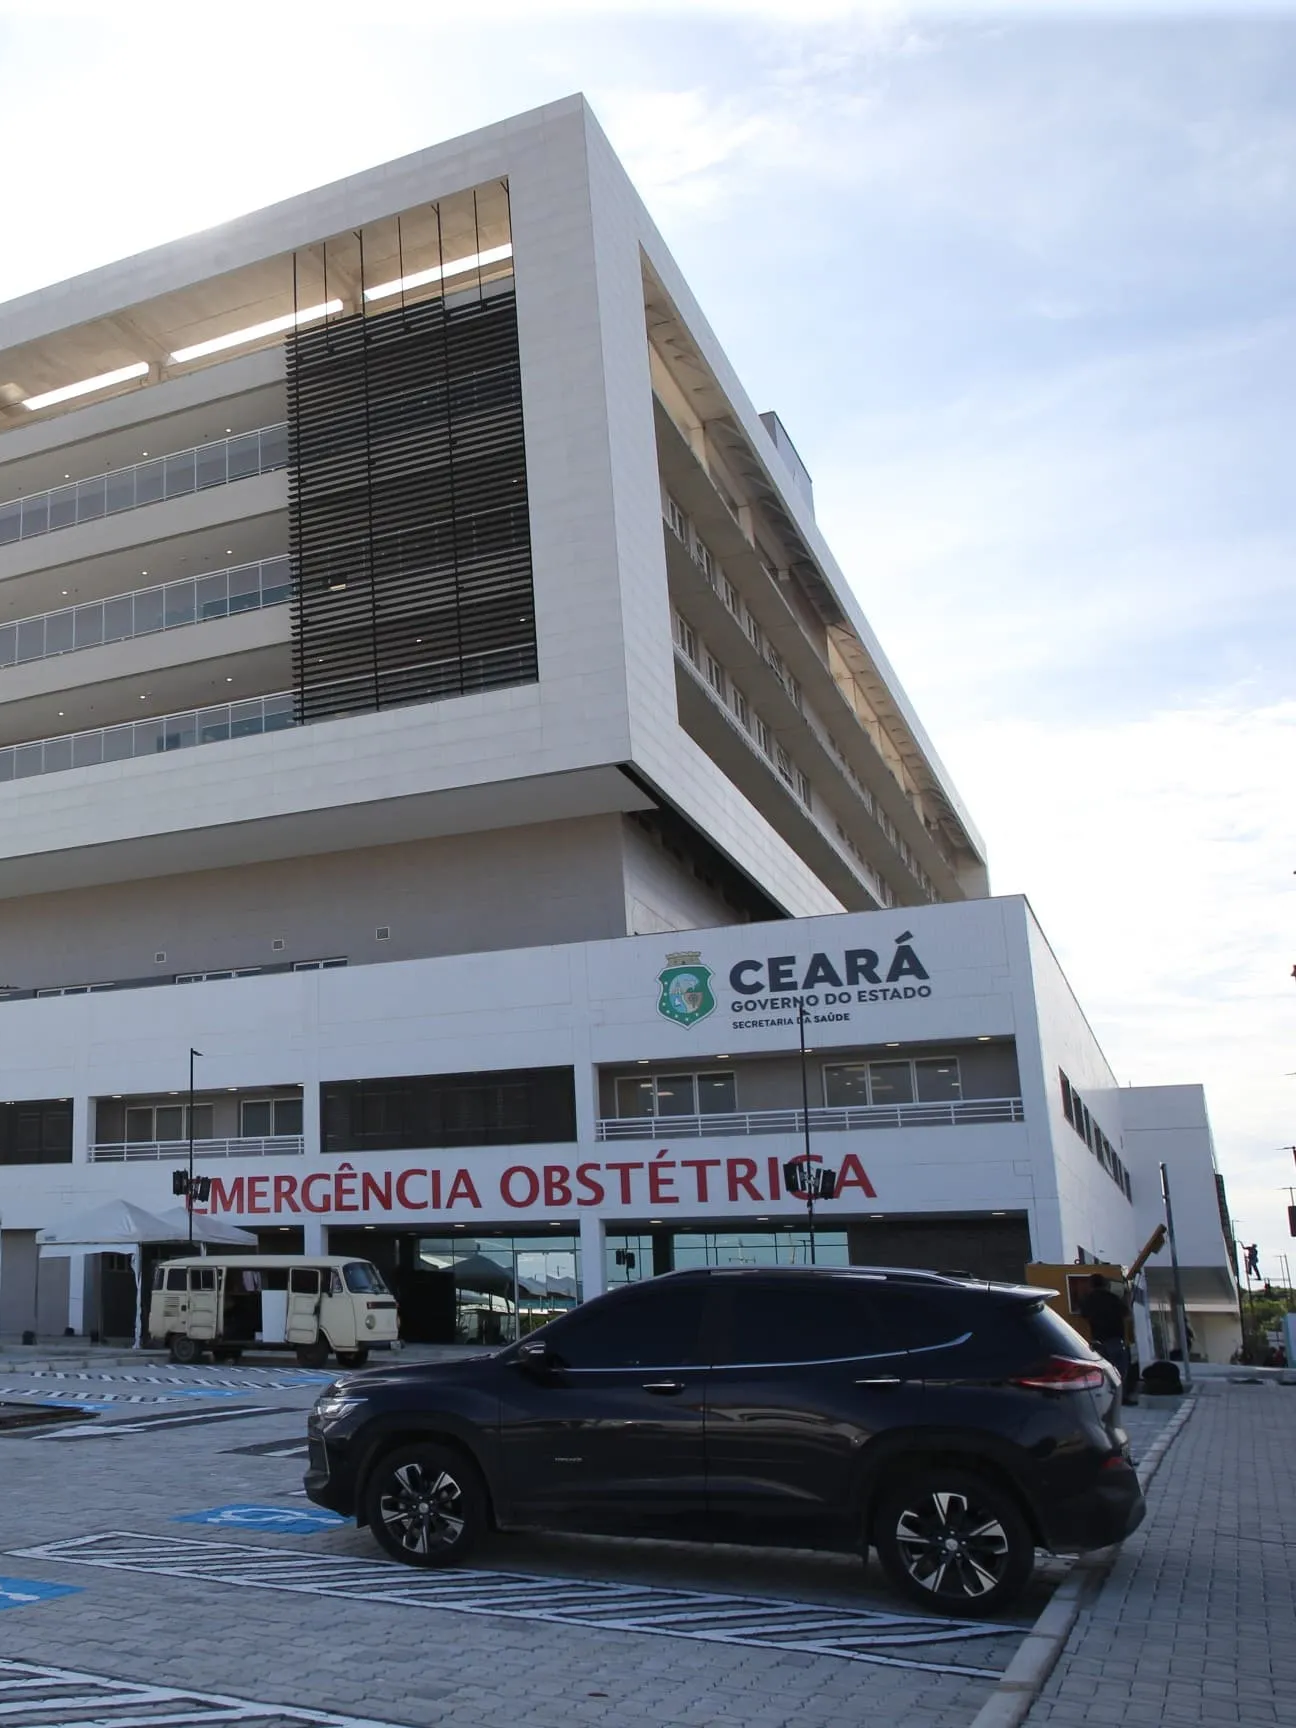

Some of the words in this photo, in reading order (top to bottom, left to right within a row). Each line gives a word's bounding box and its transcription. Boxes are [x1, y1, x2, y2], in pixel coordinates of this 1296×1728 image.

[729, 930, 930, 995] CEARÁ
[731, 994, 819, 1013] GOVERNO
[825, 992, 851, 1006] DO
[858, 985, 932, 1003] ESTADO
[732, 1017, 793, 1029] SECRETARIA
[797, 1016, 812, 1025] DA
[814, 1012, 850, 1024] SAÚDE
[185, 1163, 482, 1214] EMERGÊNCIA
[499, 1149, 877, 1208] OBSTÉTRICA
